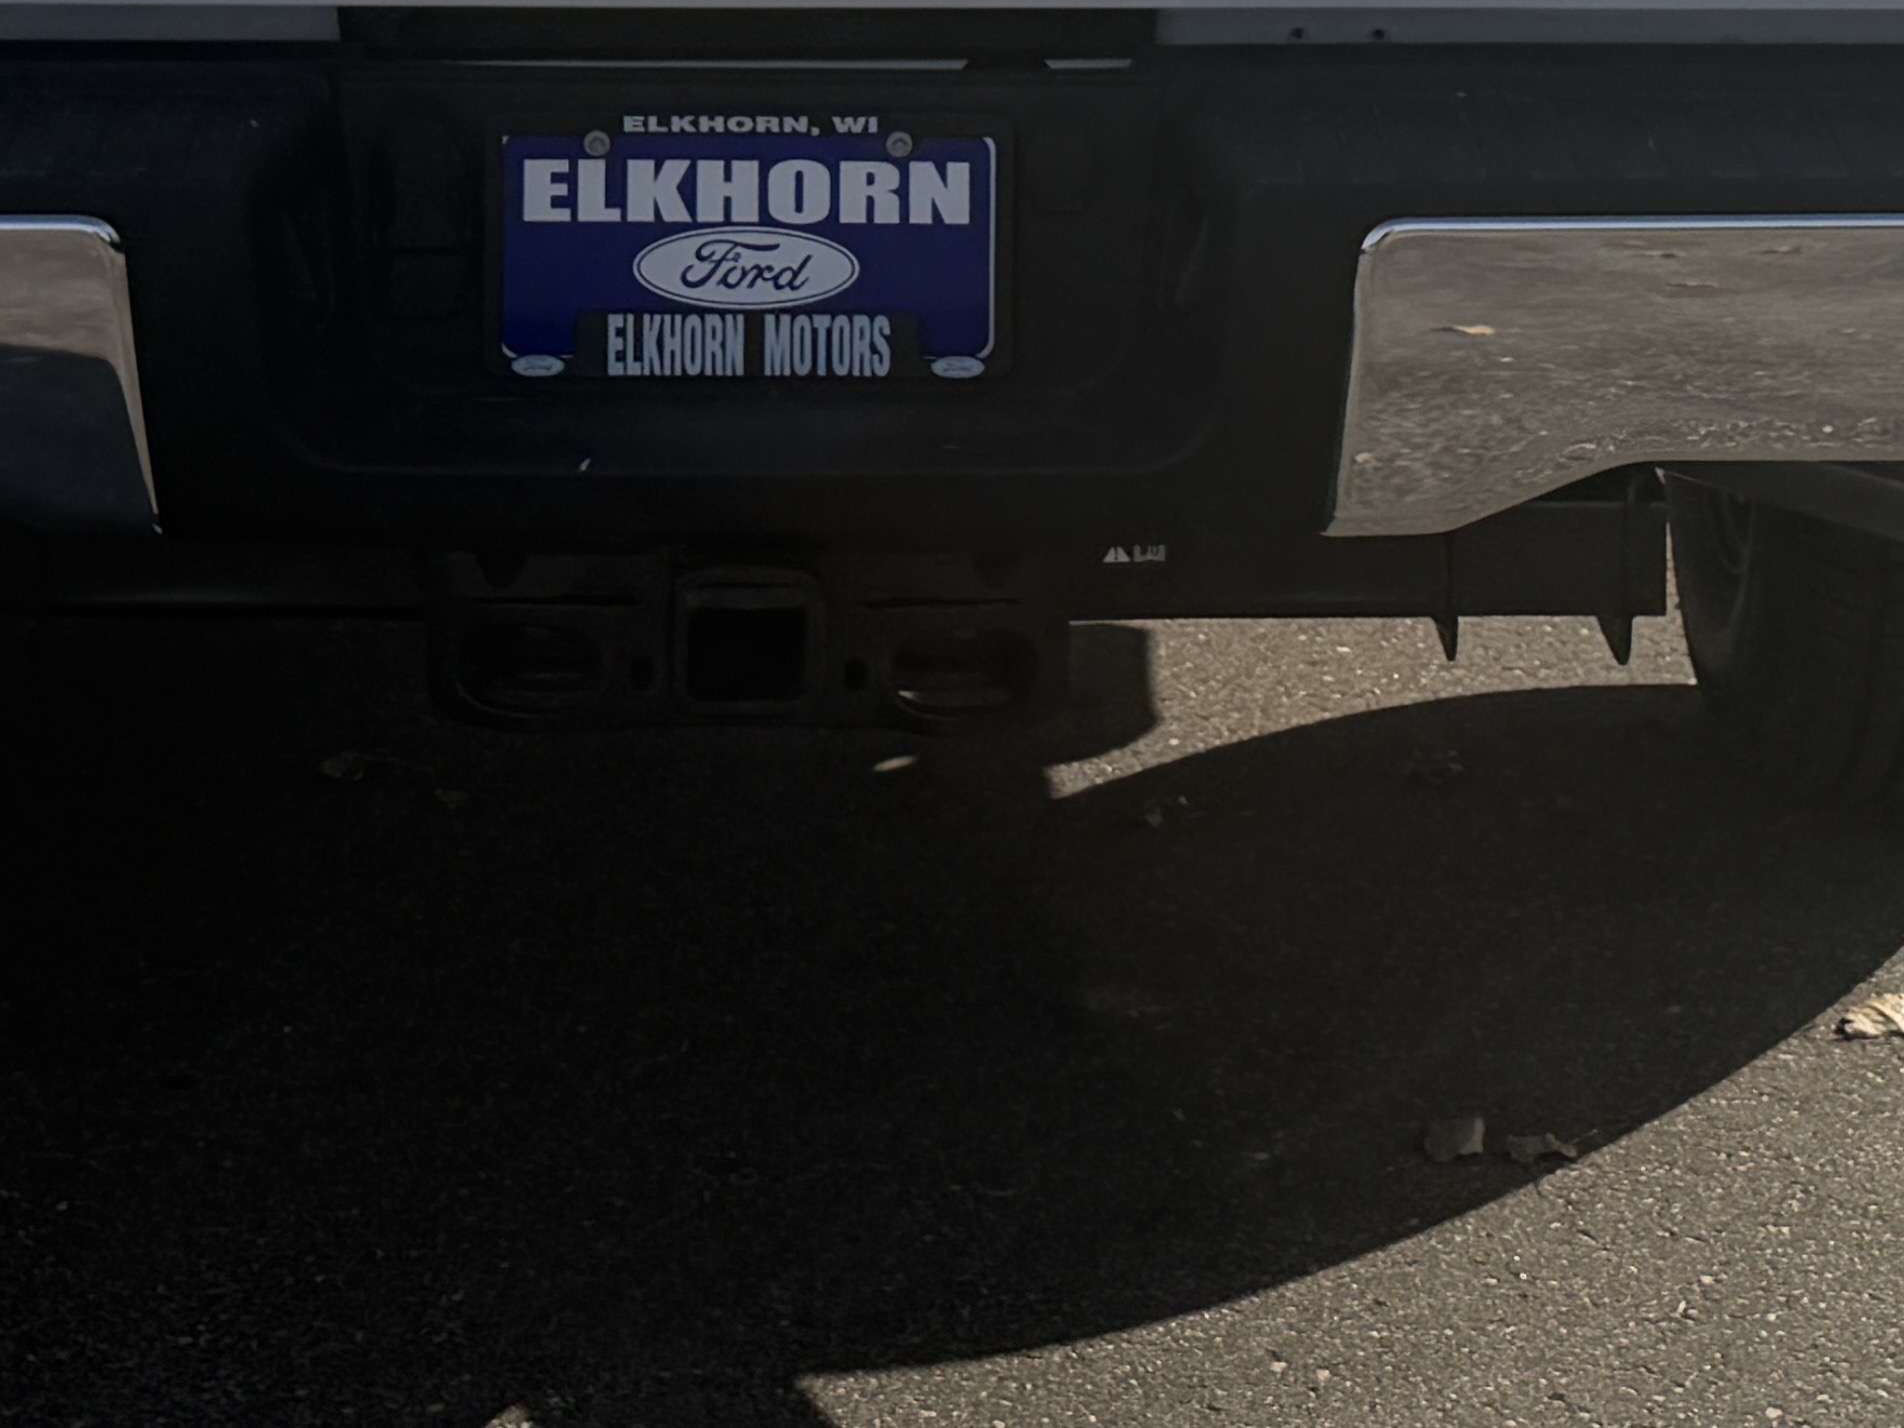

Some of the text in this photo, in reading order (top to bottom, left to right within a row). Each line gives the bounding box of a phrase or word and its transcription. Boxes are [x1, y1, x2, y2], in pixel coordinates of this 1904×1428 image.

[622, 115, 879, 136] ELKHORN, WI
[522, 158, 971, 225] ELKHORN
[680, 239, 812, 292] Ford
[606, 313, 892, 377] ELKHORN MOTORS
